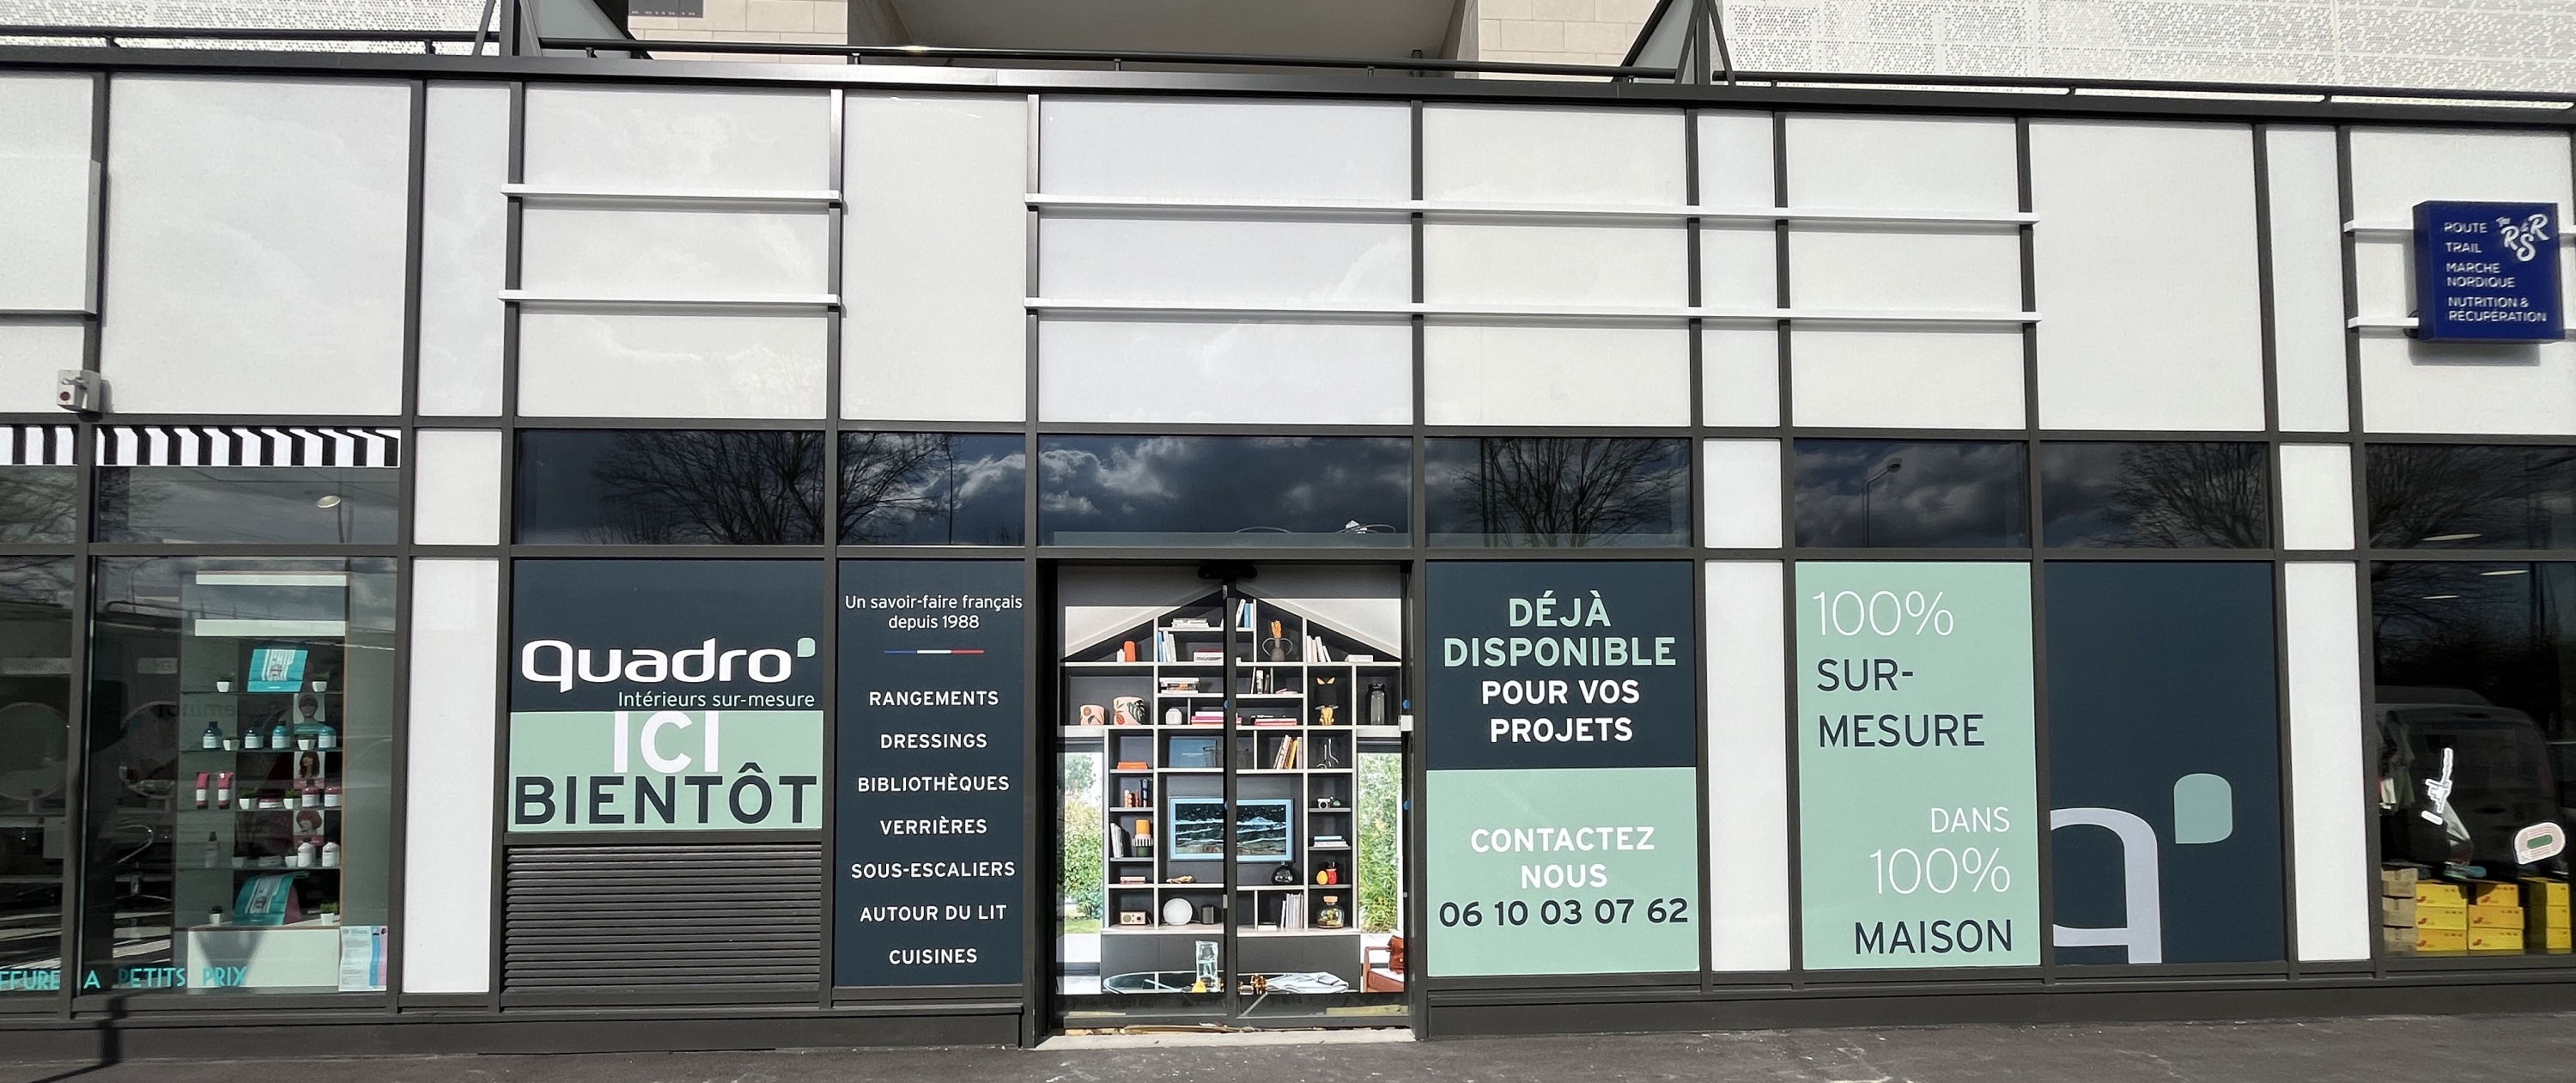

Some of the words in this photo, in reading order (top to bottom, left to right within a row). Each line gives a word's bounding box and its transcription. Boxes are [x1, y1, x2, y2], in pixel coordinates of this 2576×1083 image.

[2445, 222, 2486, 233] ROUTE
[2446, 242, 2481, 252] TRAIL
[2447, 263, 2499, 273] MARCHE
[2448, 277, 2514, 287] NORDIQUE
[2449, 297, 2517, 307] NUTRITION
[2449, 309, 2547, 322] RÉCUPÉRATION
[846, 596, 866, 608] Un
[871, 595, 957, 608] savoir-faire
[963, 595, 1022, 611] français
[1510, 590, 1611, 627] DÉJÀ
[1814, 591, 1953, 636] 100%
[889, 615, 938, 630] depuis
[943, 615, 979, 628] 1988
[1445, 637, 1675, 666] DISPONIBLE
[1818, 659, 1913, 691] SUR-
[619, 691, 706, 706] Intérieurs
[713, 696, 814, 707] sur-mesure
[870, 691, 998, 705] RANGEMENTS
[1483, 680, 1567, 704] POUR
[1579, 680, 1639, 703] VOS
[1492, 717, 1632, 742] PROJETS
[1820, 715, 1984, 747] MESURE
[614, 712, 719, 773] ICI
[881, 733, 987, 748] DRESSINGS
[859, 773, 1009, 791] BIBLIOTHÈQUES
[515, 762, 817, 824] BIENTÔT
[880, 816, 987, 835] VERRIÈRES
[1931, 806, 2009, 832] DANS
[1471, 827, 1654, 852] CONTACTEZ
[852, 861, 1014, 878] SOUS-ESCALIERS
[1522, 864, 1607, 888] NOUS
[1870, 848, 2010, 894] 100%
[860, 906, 938, 922] AUTOUR
[946, 905, 970, 920] DU
[979, 905, 1006, 919] LIT
[1440, 902, 1482, 927] 06
[1495, 901, 1528, 925] 10
[1541, 900, 1582, 924] 03
[1595, 899, 1634, 924] 07
[1648, 898, 1687, 923] 62
[1856, 920, 2011, 954] MAISON
[890, 948, 976, 964] CUISINES
[83, 970, 100, 989] A
[118, 967, 185, 987] PETITS
[204, 966, 246, 987] PRIX
